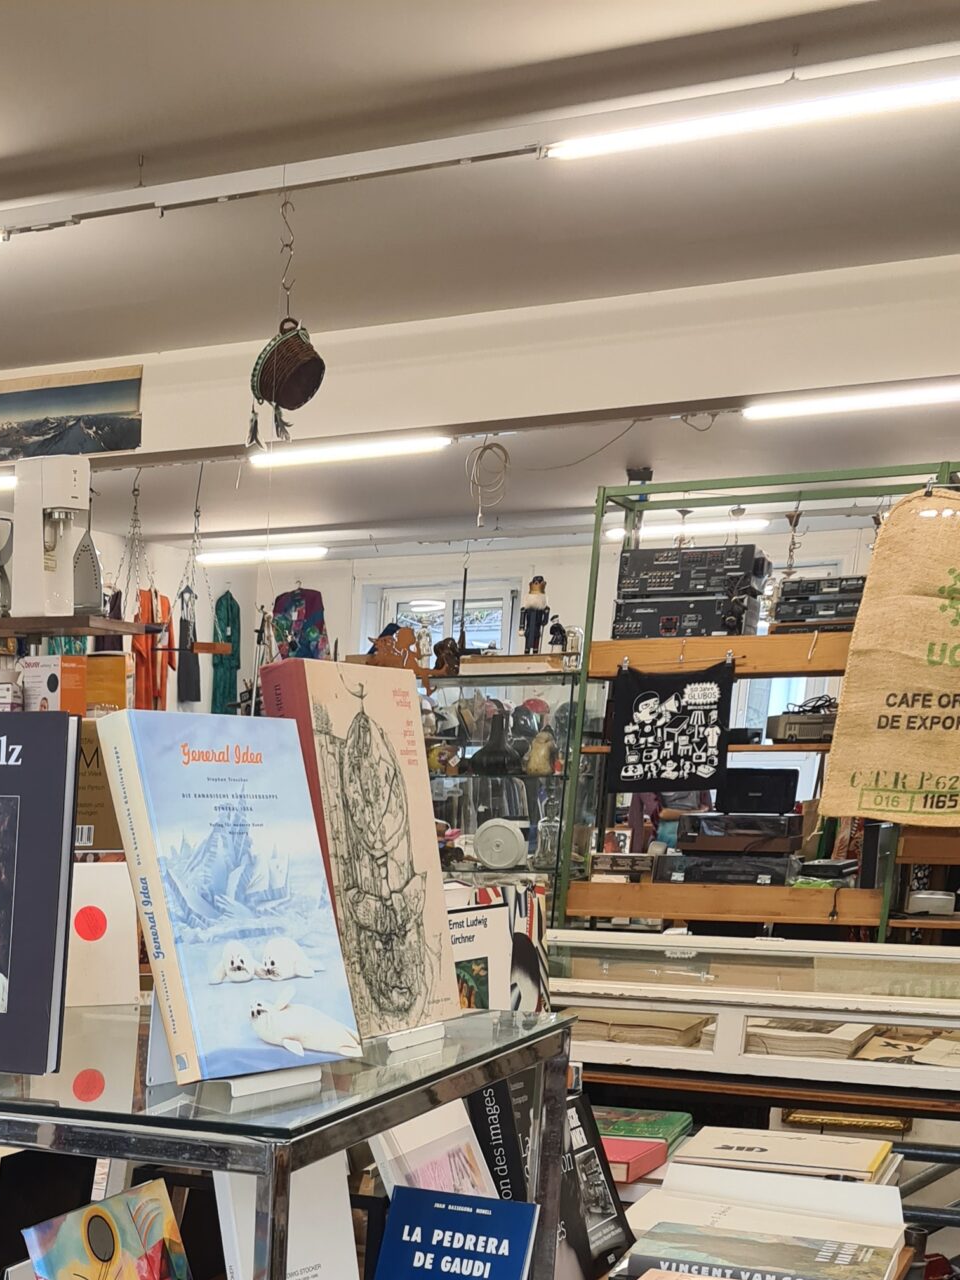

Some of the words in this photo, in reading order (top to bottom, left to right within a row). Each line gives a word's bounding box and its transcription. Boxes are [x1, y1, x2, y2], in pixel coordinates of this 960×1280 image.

[886, 693, 932, 708] CAFE
[877, 715, 900, 729] DE
[181, 742, 229, 765] General
[234, 744, 263, 764] Idea
[140, 877, 154, 906] Idea
[146, 908, 165, 960] General
[448, 919, 465, 930] Ernst
[466, 915, 488, 928] Ludwig
[482, 1087, 504, 1146] images
[493, 1146, 509, 1176] des
[402, 1225, 422, 1243] LA
[431, 1229, 510, 1256] PEDRERA
[412, 1251, 435, 1270] DE
[440, 1255, 492, 1279] GAUDI
[659, 1260, 734, 1280] VINCENT
